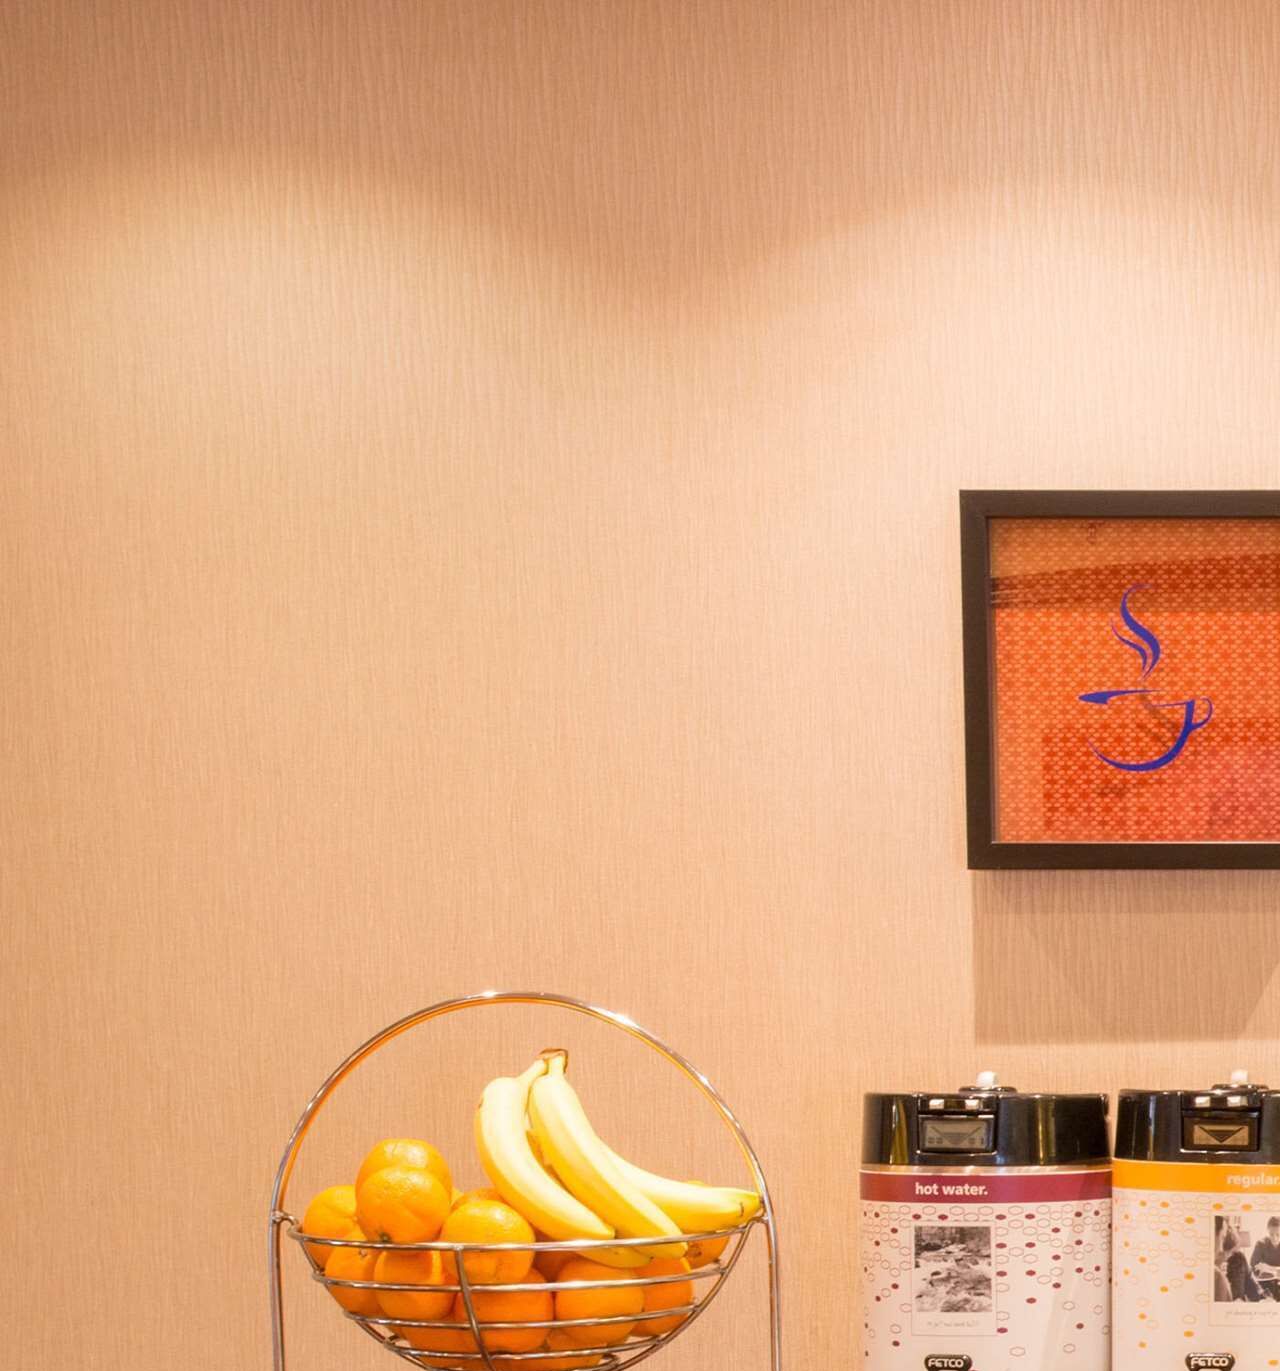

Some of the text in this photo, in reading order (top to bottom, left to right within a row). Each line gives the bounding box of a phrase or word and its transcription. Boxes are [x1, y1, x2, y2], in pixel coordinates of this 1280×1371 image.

[915, 1182, 988, 1197] hot water.
[928, 1358, 964, 1370] FETCO
[1190, 1357, 1229, 1369] FETCO
